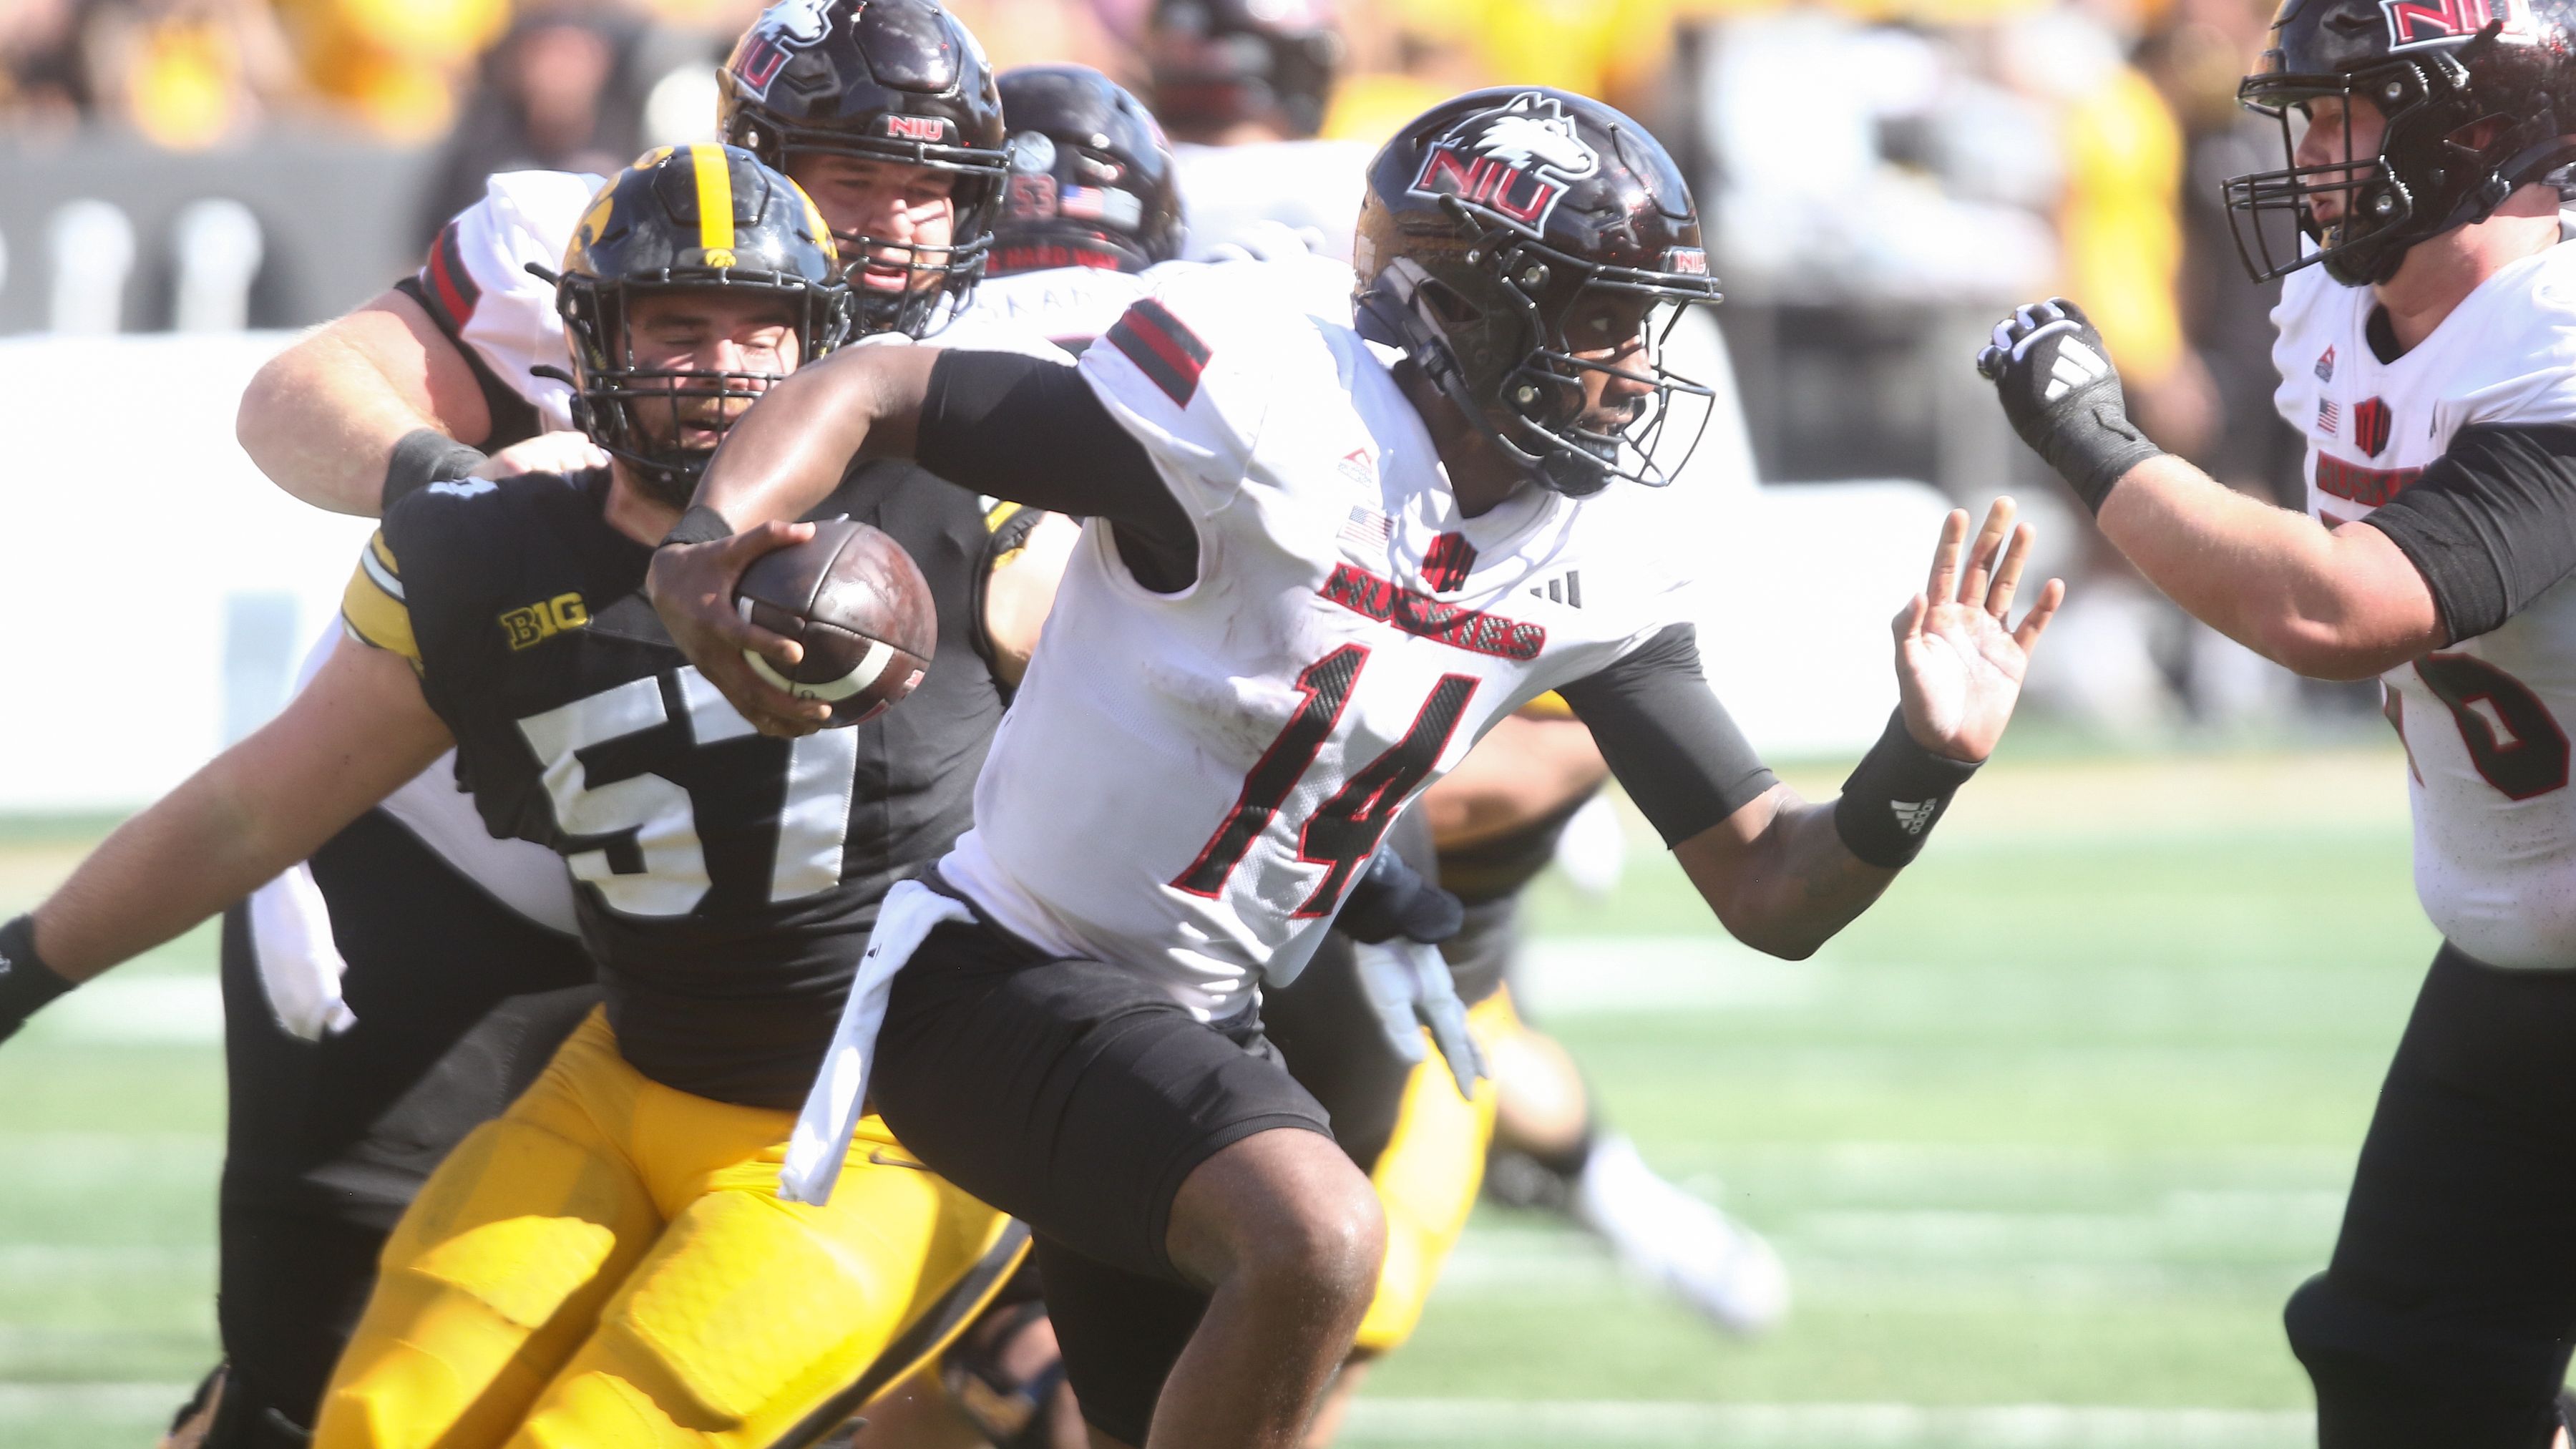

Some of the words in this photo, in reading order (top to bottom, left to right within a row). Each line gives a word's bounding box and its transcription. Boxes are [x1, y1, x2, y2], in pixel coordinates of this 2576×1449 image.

[887, 115, 943, 142] NIU
[1013, 172, 1058, 220] 53
[1415, 149, 1555, 223] NIU
[1317, 562, 1547, 661] HUSKIES
[515, 665, 859, 917] 57
[1169, 643, 1482, 919] 14
